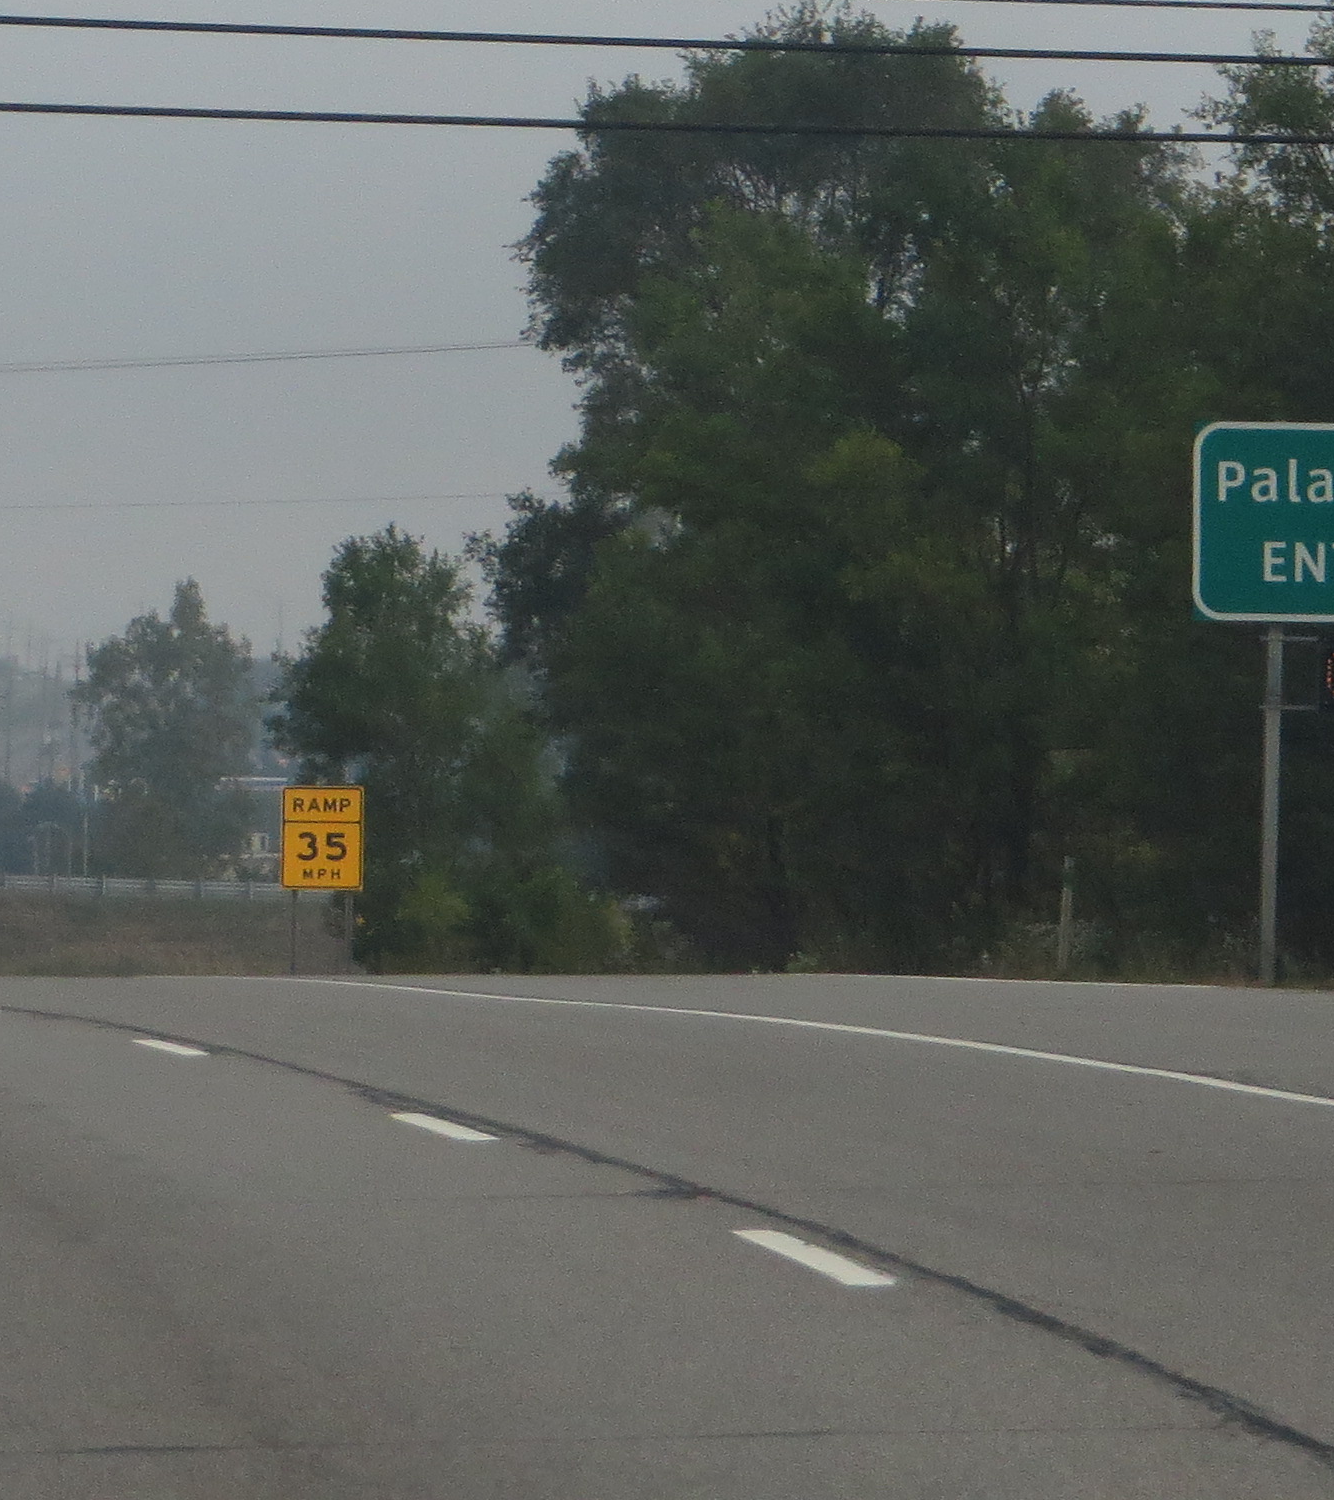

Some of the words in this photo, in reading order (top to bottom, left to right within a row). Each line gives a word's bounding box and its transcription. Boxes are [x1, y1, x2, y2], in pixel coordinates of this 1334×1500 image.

[293, 797, 351, 812] RAMP
[297, 831, 348, 861] 35
[302, 868, 341, 880] MPH
